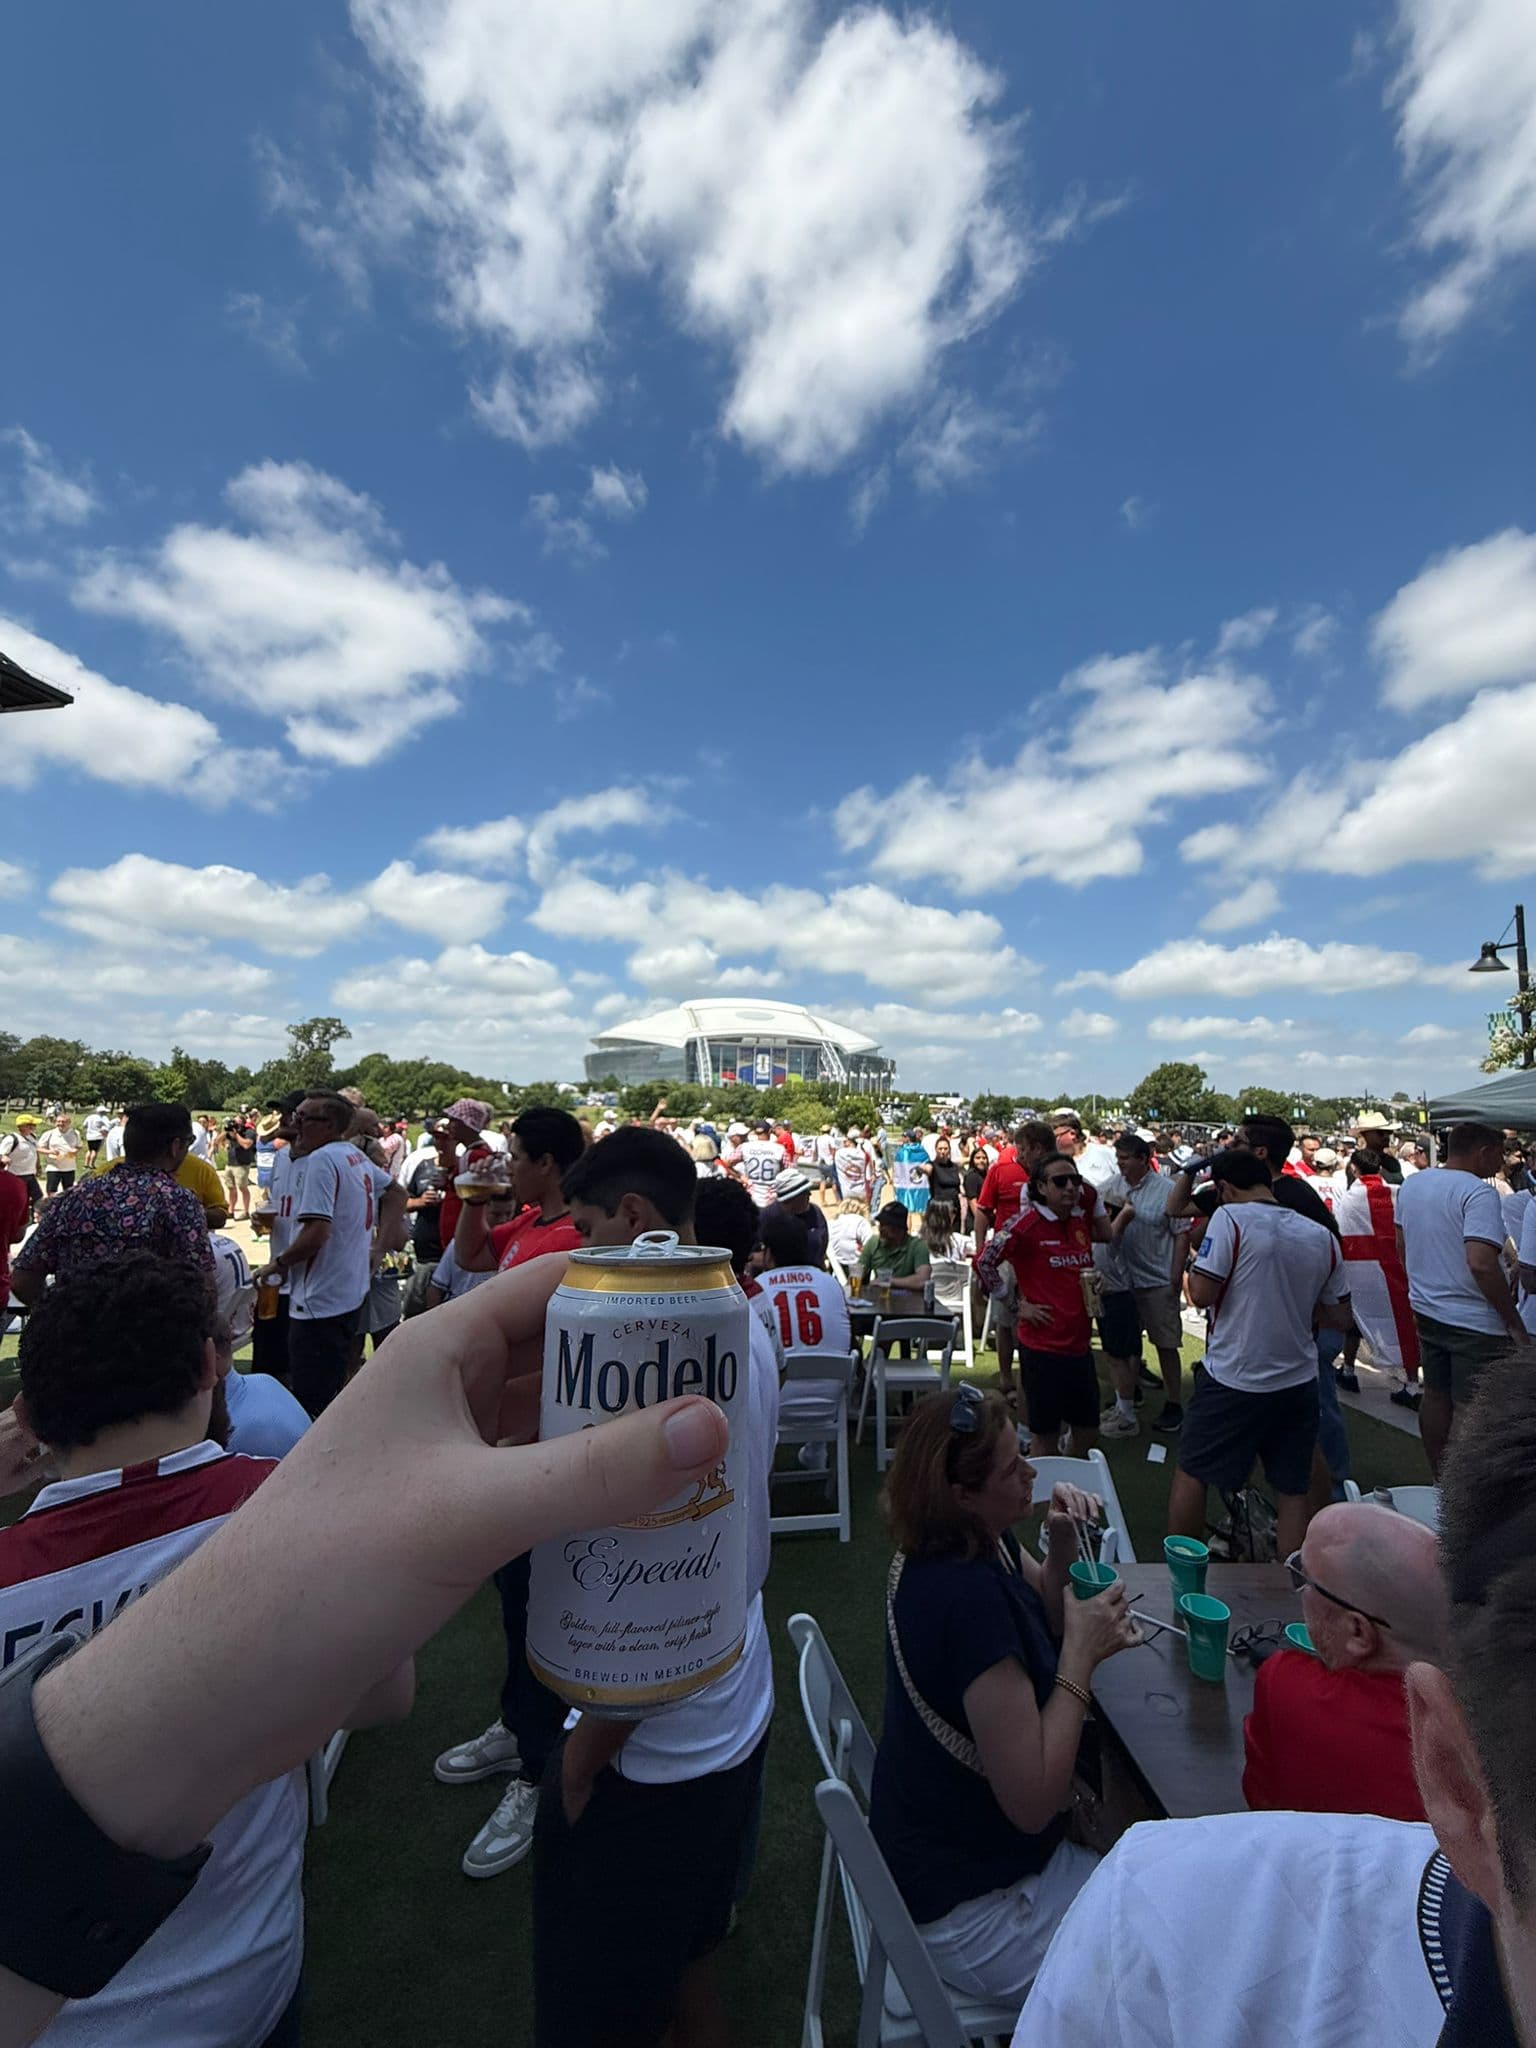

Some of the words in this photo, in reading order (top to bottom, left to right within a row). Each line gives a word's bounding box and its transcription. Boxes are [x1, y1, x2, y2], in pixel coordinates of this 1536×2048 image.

[748, 1157, 775, 1181] 26
[769, 1272, 813, 1286] MAINOO
[606, 1296, 665, 1305] IMPORTED
[669, 1295, 698, 1305] BEER
[612, 1319, 690, 1339] CERVEZA
[773, 1290, 823, 1348] 16
[555, 1328, 737, 1413] Modelo
[574, 1668, 629, 1683] BREWED
[635, 1672, 648, 1682] IN
[655, 1658, 704, 1680] MEXICO
